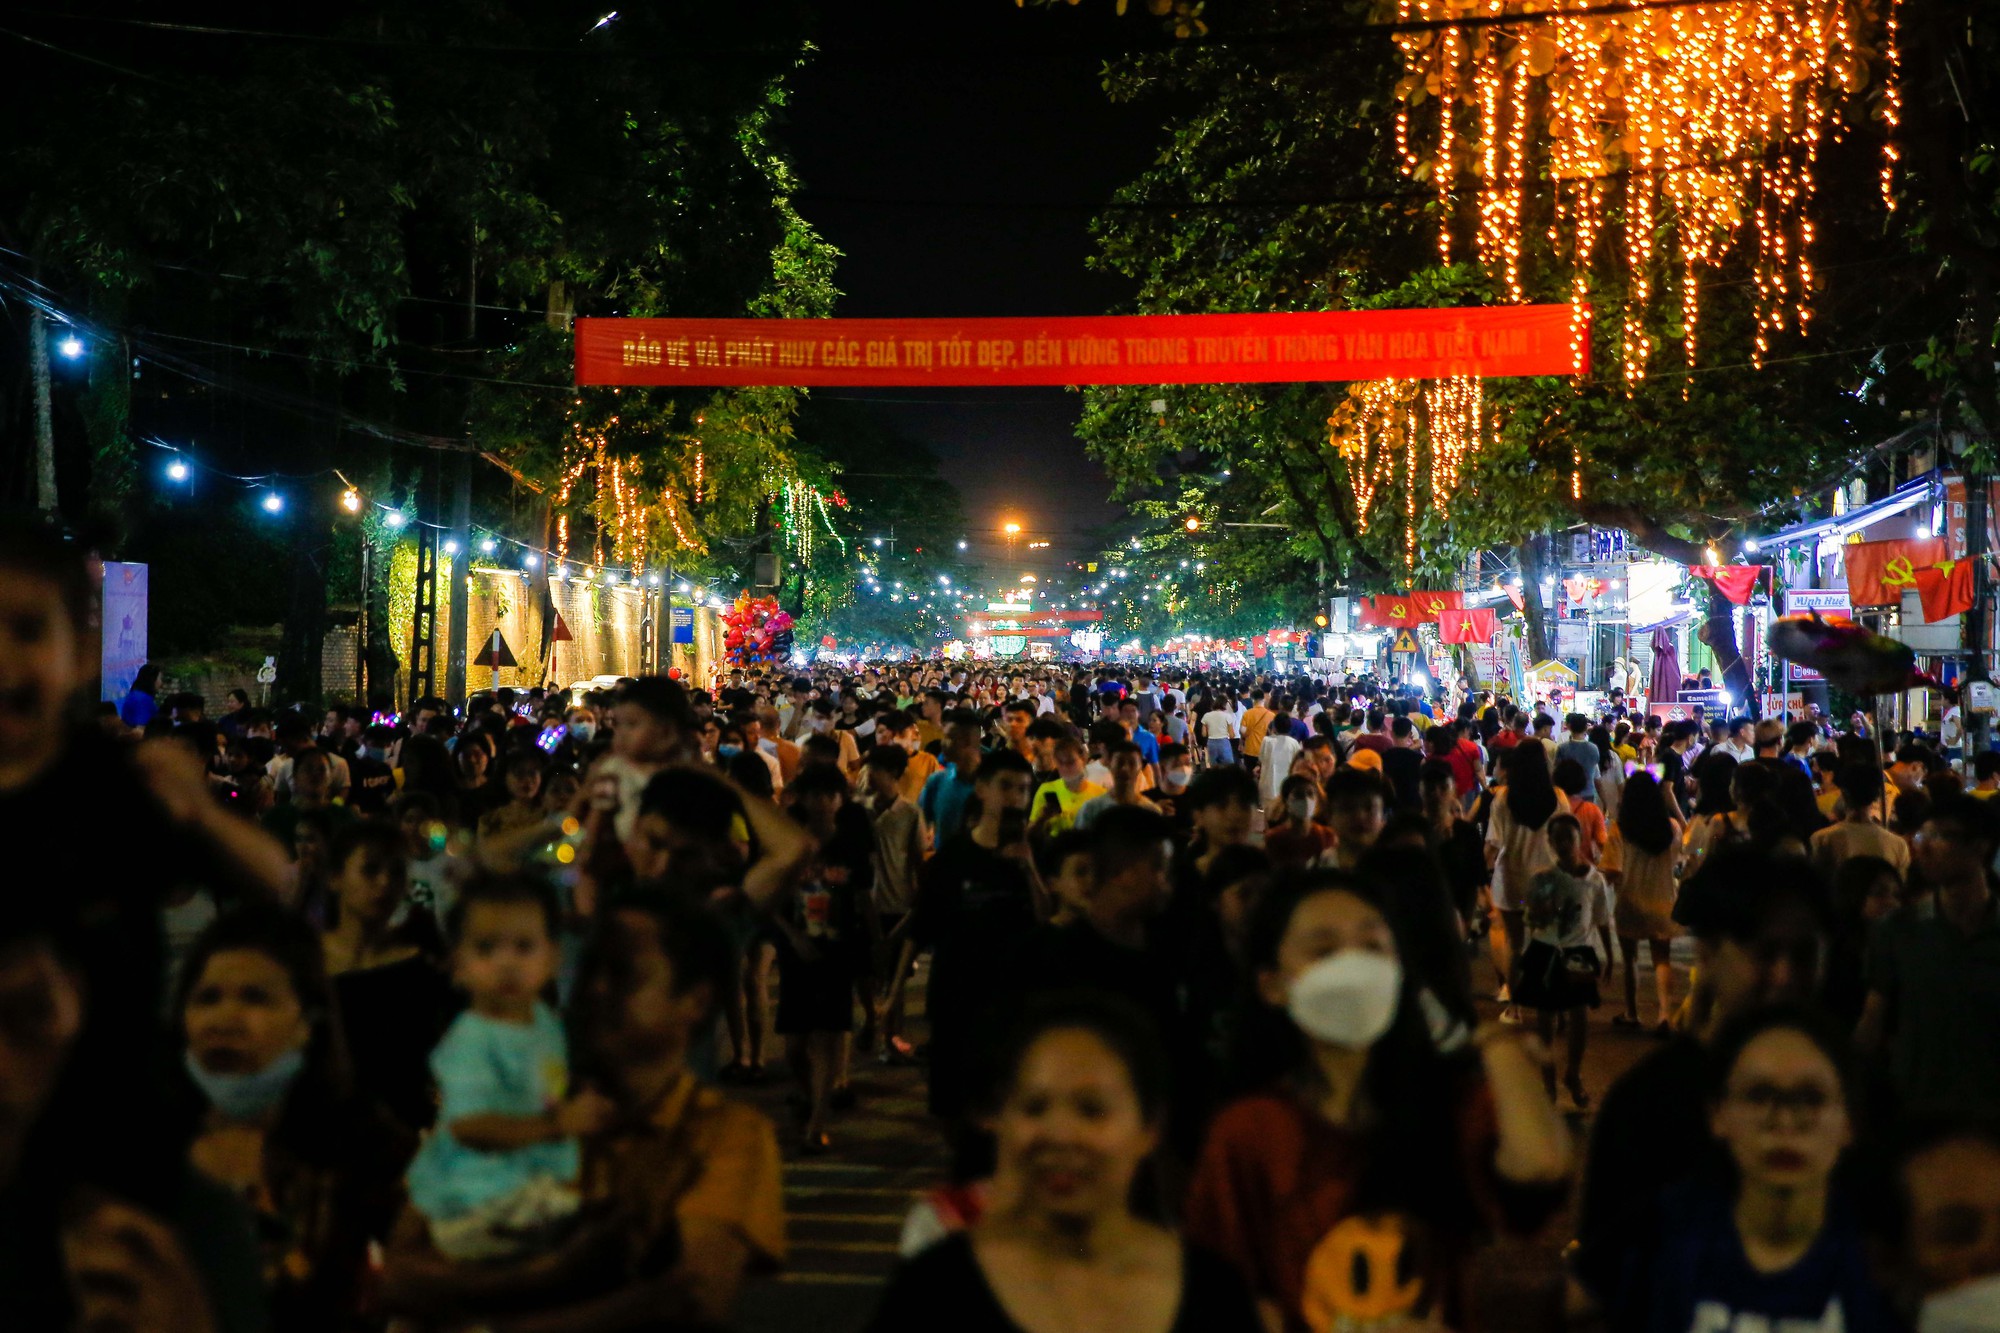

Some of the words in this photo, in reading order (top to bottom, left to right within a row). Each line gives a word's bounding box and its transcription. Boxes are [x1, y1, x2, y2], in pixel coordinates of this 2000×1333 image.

[623, 331, 661, 366] BẢO
[666, 334, 690, 372] VỆ
[694, 333, 720, 367] VÀ
[725, 335, 774, 367] PHÁT
[778, 340, 816, 367] HUY
[822, 334, 860, 368] CÁC
[866, 334, 899, 368] GIÁ
[903, 340, 933, 372] TRỊ
[938, 330, 972, 368] TỐT
[1124, 337, 1189, 365] TRONG
[1481, 328, 1528, 357] NAM
[1794, 596, 1821, 606] Minh
